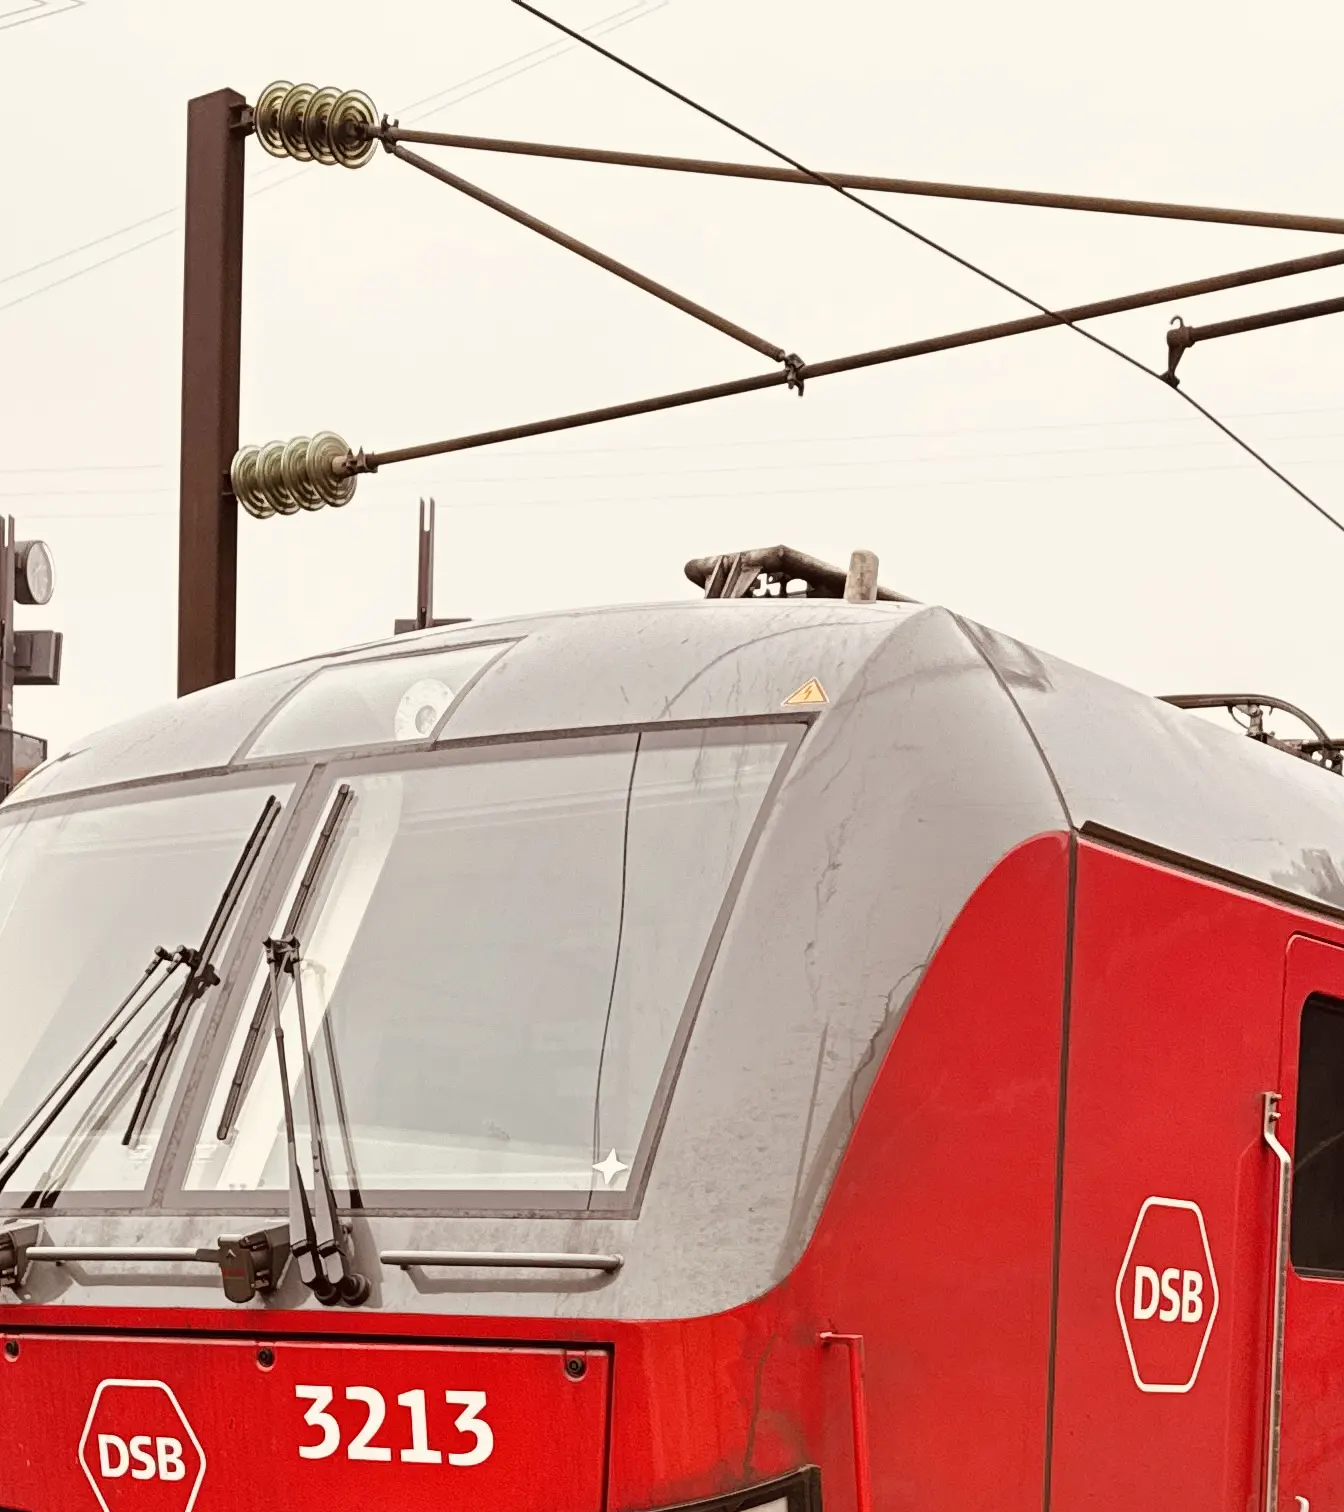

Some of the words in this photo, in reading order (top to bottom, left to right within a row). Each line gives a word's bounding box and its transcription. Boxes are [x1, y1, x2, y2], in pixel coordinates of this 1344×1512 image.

[1134, 1266, 1203, 1323] DSB
[295, 1384, 494, 1467] 3213
[97, 1433, 186, 1481] DSB
